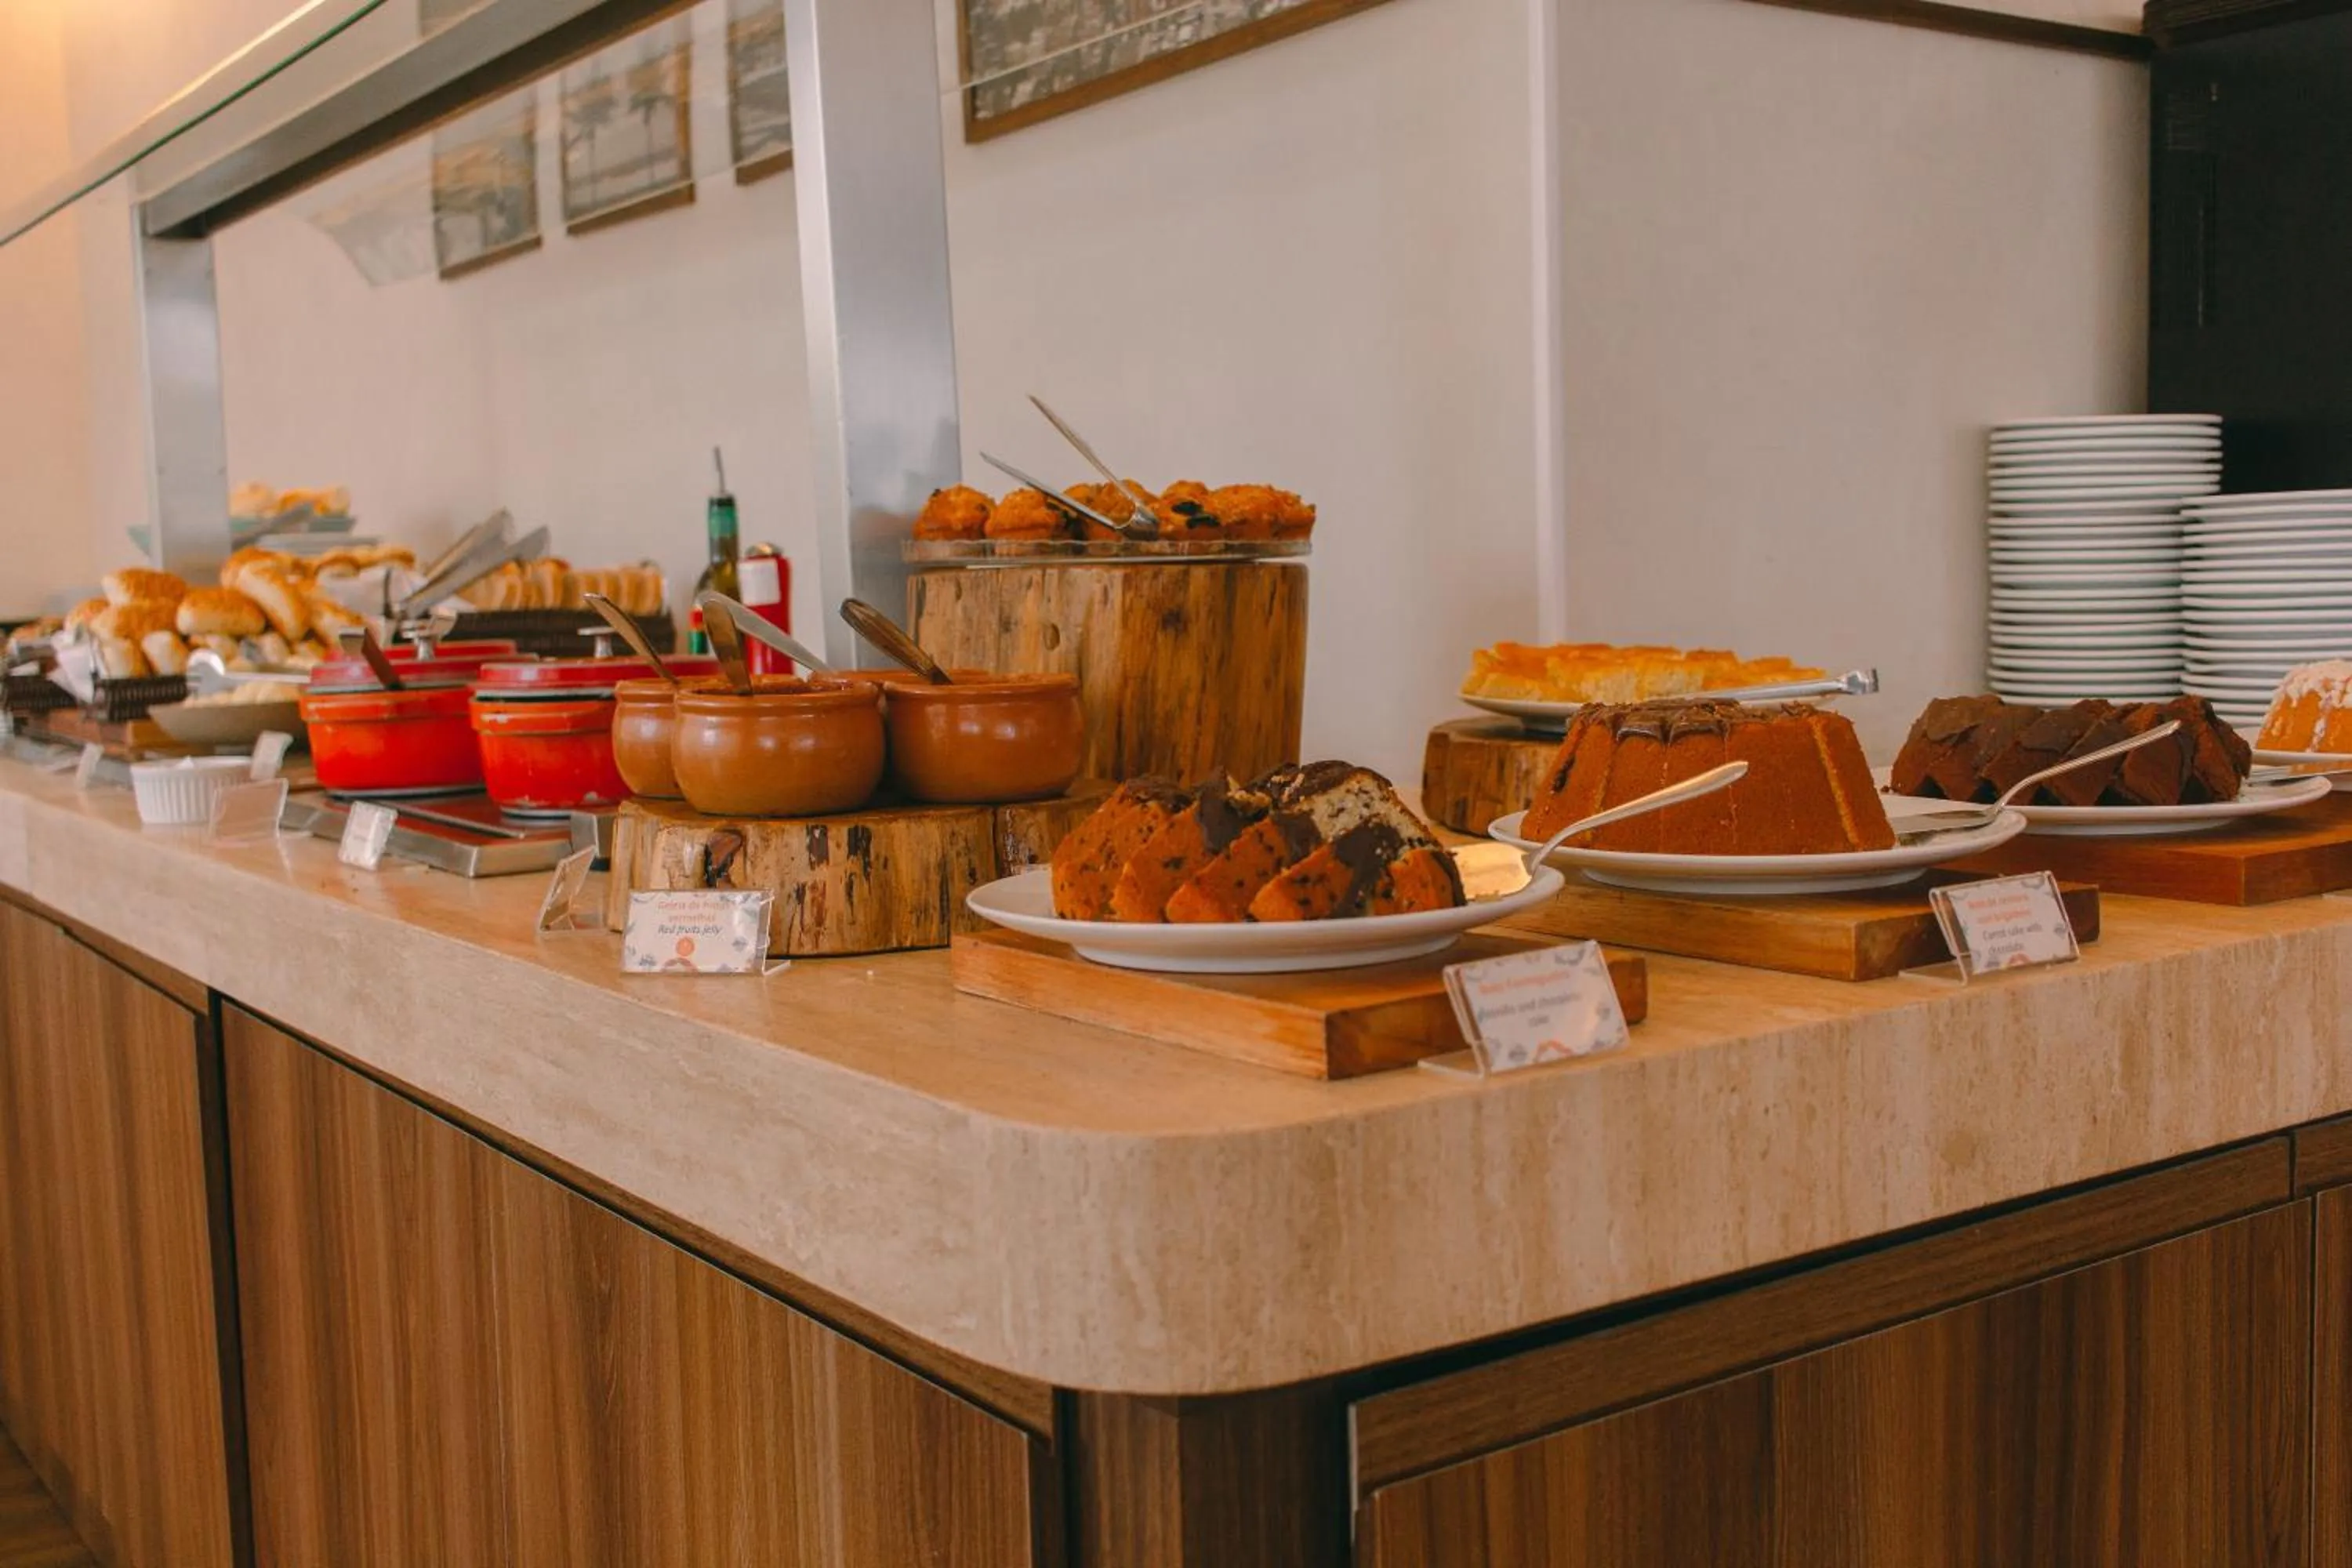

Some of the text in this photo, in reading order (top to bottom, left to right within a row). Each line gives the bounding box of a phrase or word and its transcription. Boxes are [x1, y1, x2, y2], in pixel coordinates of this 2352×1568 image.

[658, 924, 722, 935] Red fruits jelly
